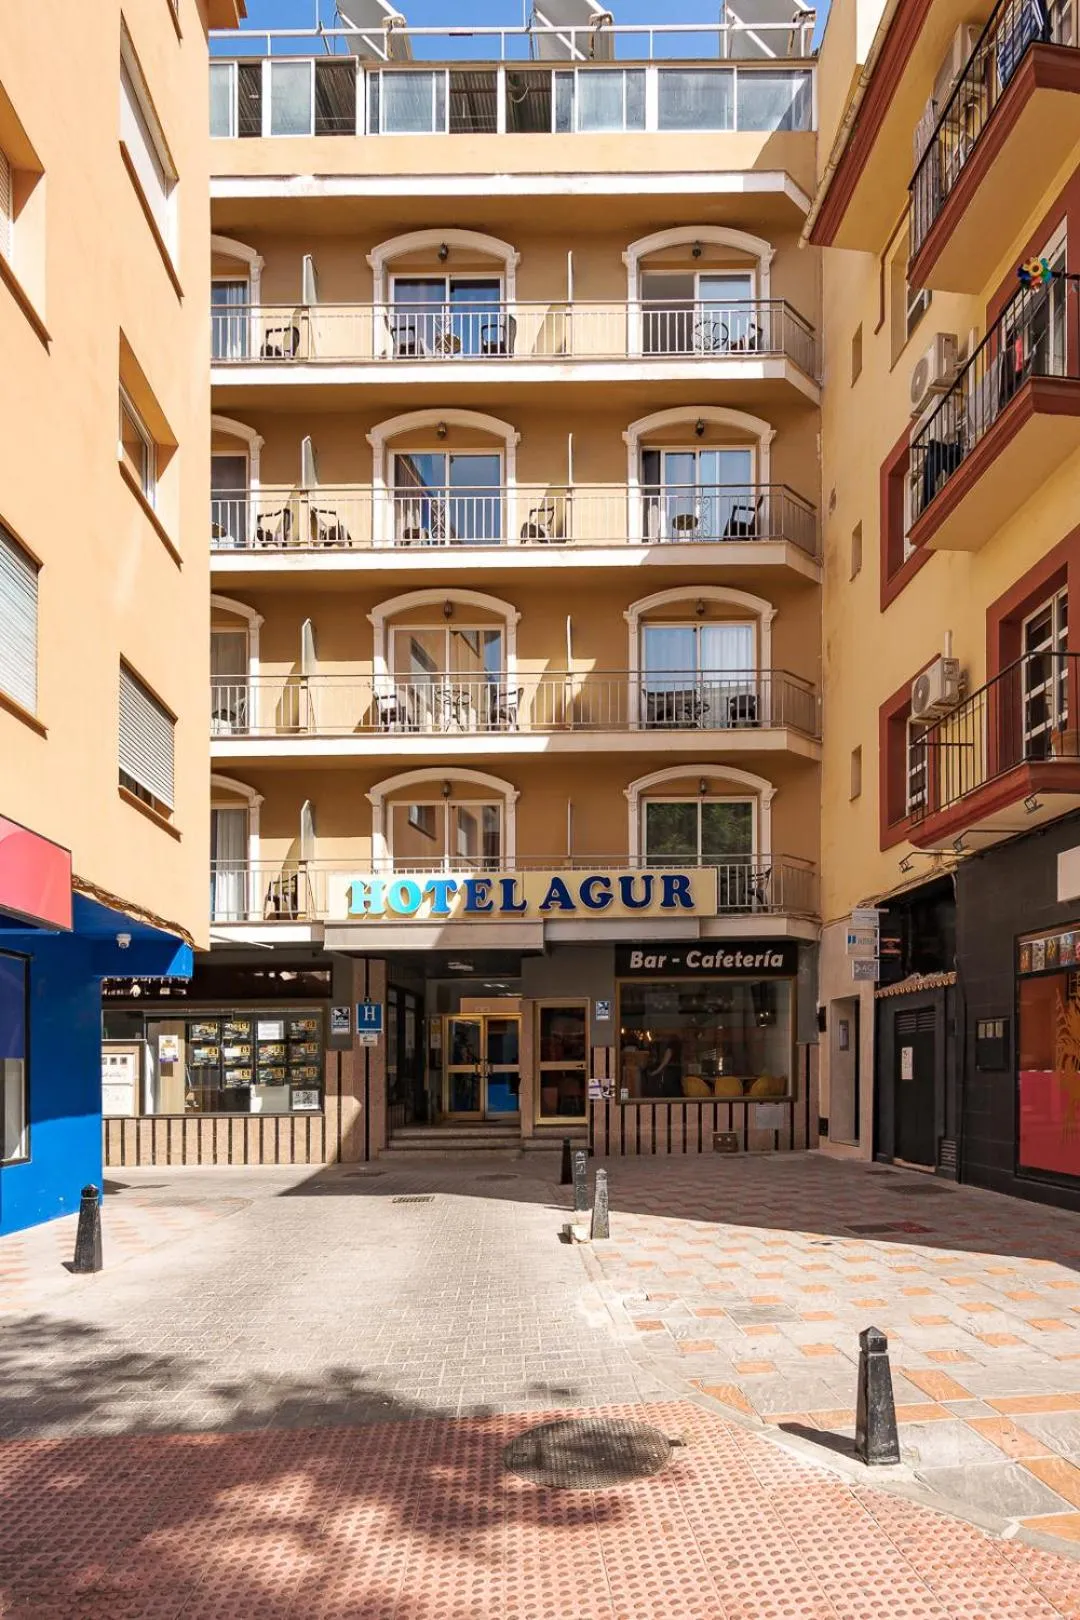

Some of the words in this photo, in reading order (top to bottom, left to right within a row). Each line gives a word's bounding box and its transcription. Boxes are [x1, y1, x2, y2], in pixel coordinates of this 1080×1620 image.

[349, 878, 528, 914] HOTEL
[539, 875, 695, 912] AGUR
[630, 951, 667, 968] Bar
[686, 950, 783, 968] Cafetería
[363, 1005, 376, 1021] H
